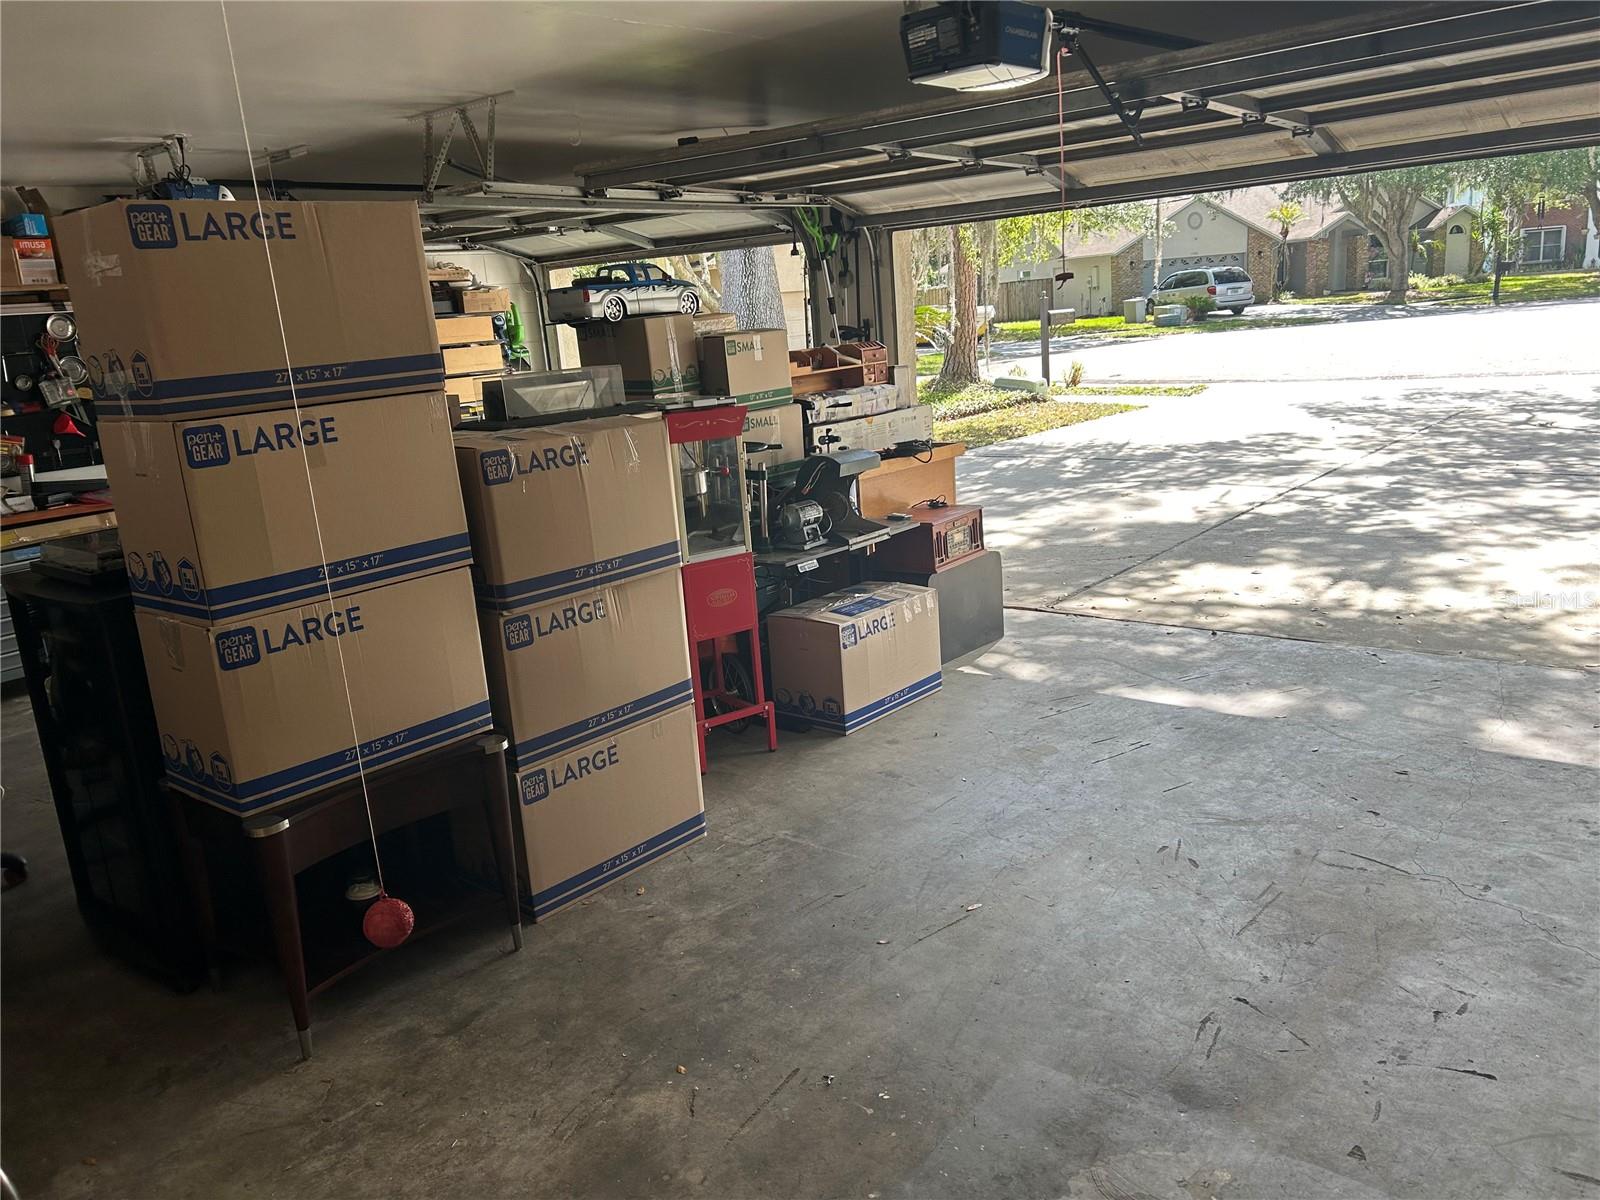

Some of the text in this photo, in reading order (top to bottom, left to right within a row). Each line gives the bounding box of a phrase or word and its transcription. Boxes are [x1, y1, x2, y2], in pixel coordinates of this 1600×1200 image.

[137, 223, 171, 242] GEAR
[179, 212, 296, 241] LARGE
[750, 416, 778, 429] SMALL
[232, 416, 338, 456] LARGE
[192, 442, 224, 462] GEAR
[513, 442, 589, 475] LARGE
[487, 463, 509, 480] GEAR
[535, 598, 606, 637] LARGE
[262, 605, 364, 654] LARGE
[509, 628, 530, 645] GEAR
[224, 644, 255, 664] GEAR
[551, 744, 619, 789] LARGE
[525, 782, 546, 800] GEAR
